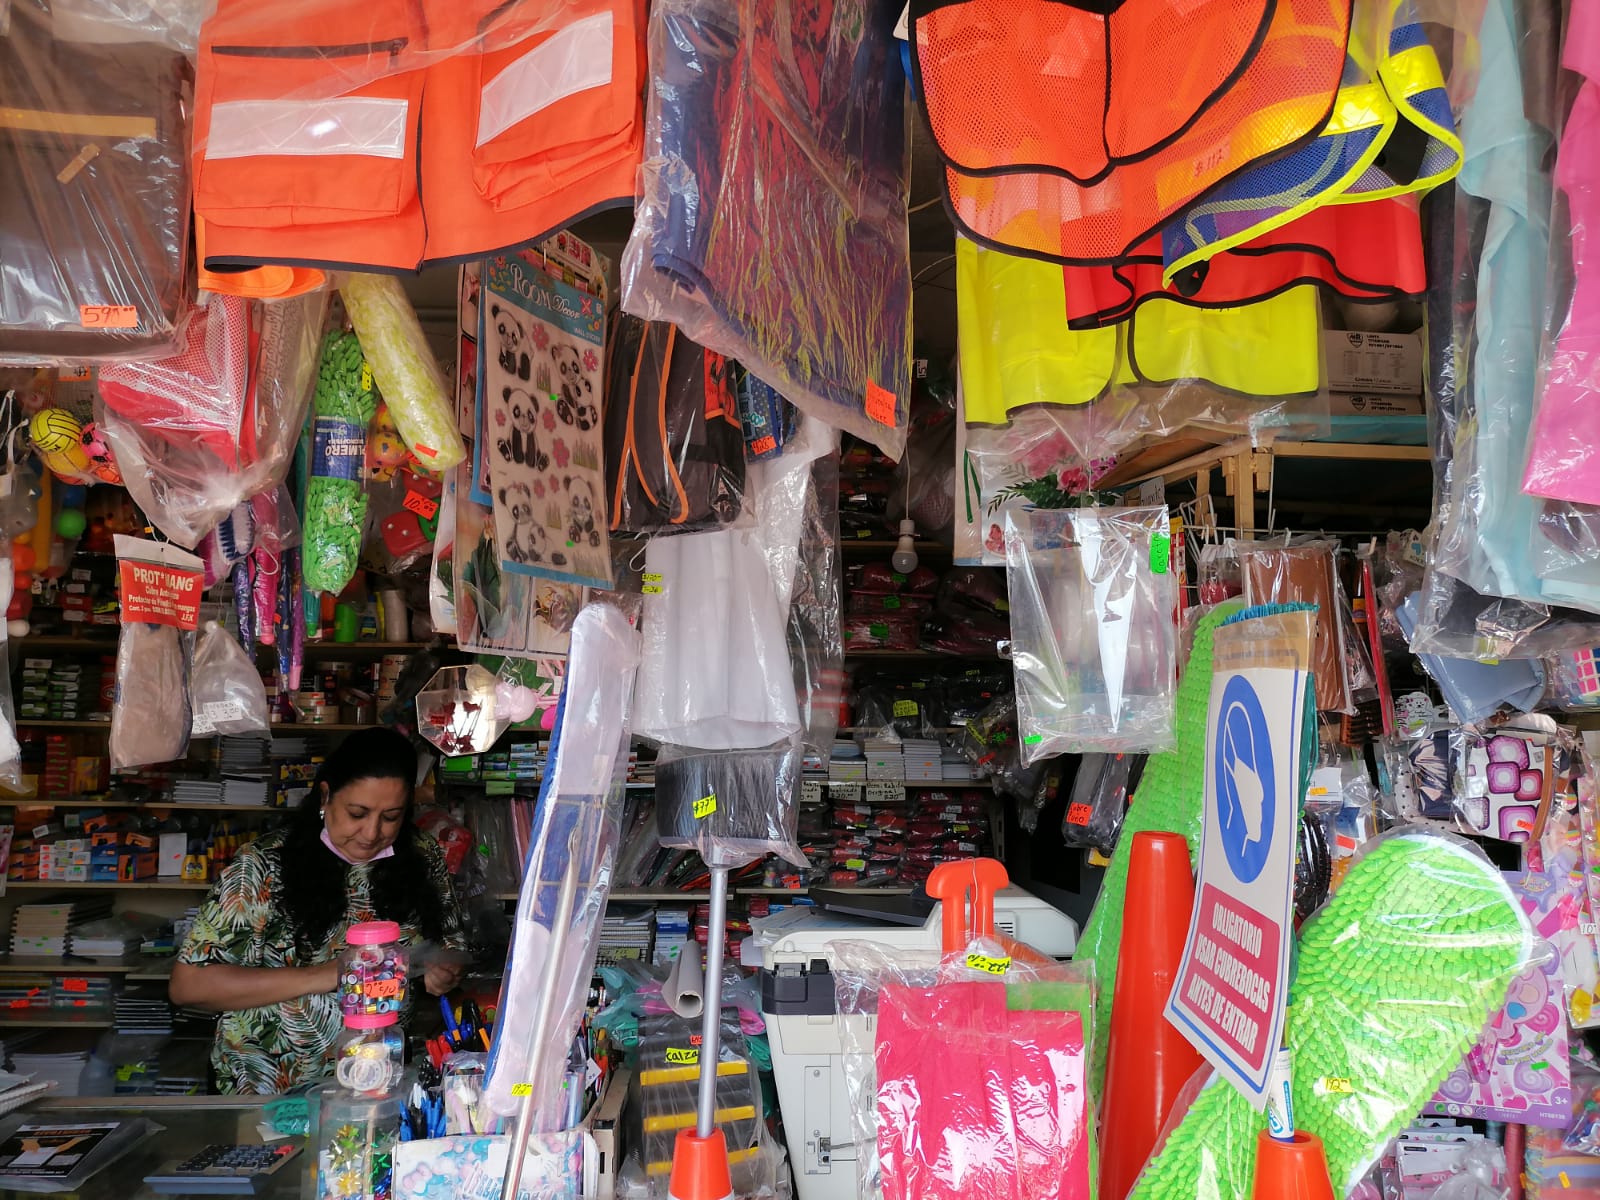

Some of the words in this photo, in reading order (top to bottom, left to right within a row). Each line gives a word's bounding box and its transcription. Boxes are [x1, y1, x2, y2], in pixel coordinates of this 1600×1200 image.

[1213, 902, 1262, 959] OBLIGATORIO
[1195, 932, 1217, 970] USAR
[1214, 947, 1270, 1013] CUBREBOCAS
[1187, 973, 1215, 1014] ANTES
[1210, 991, 1226, 1024] DE
[1221, 999, 1259, 1054] ENTRAR
[1554, 1096, 1568, 1105] 3+
